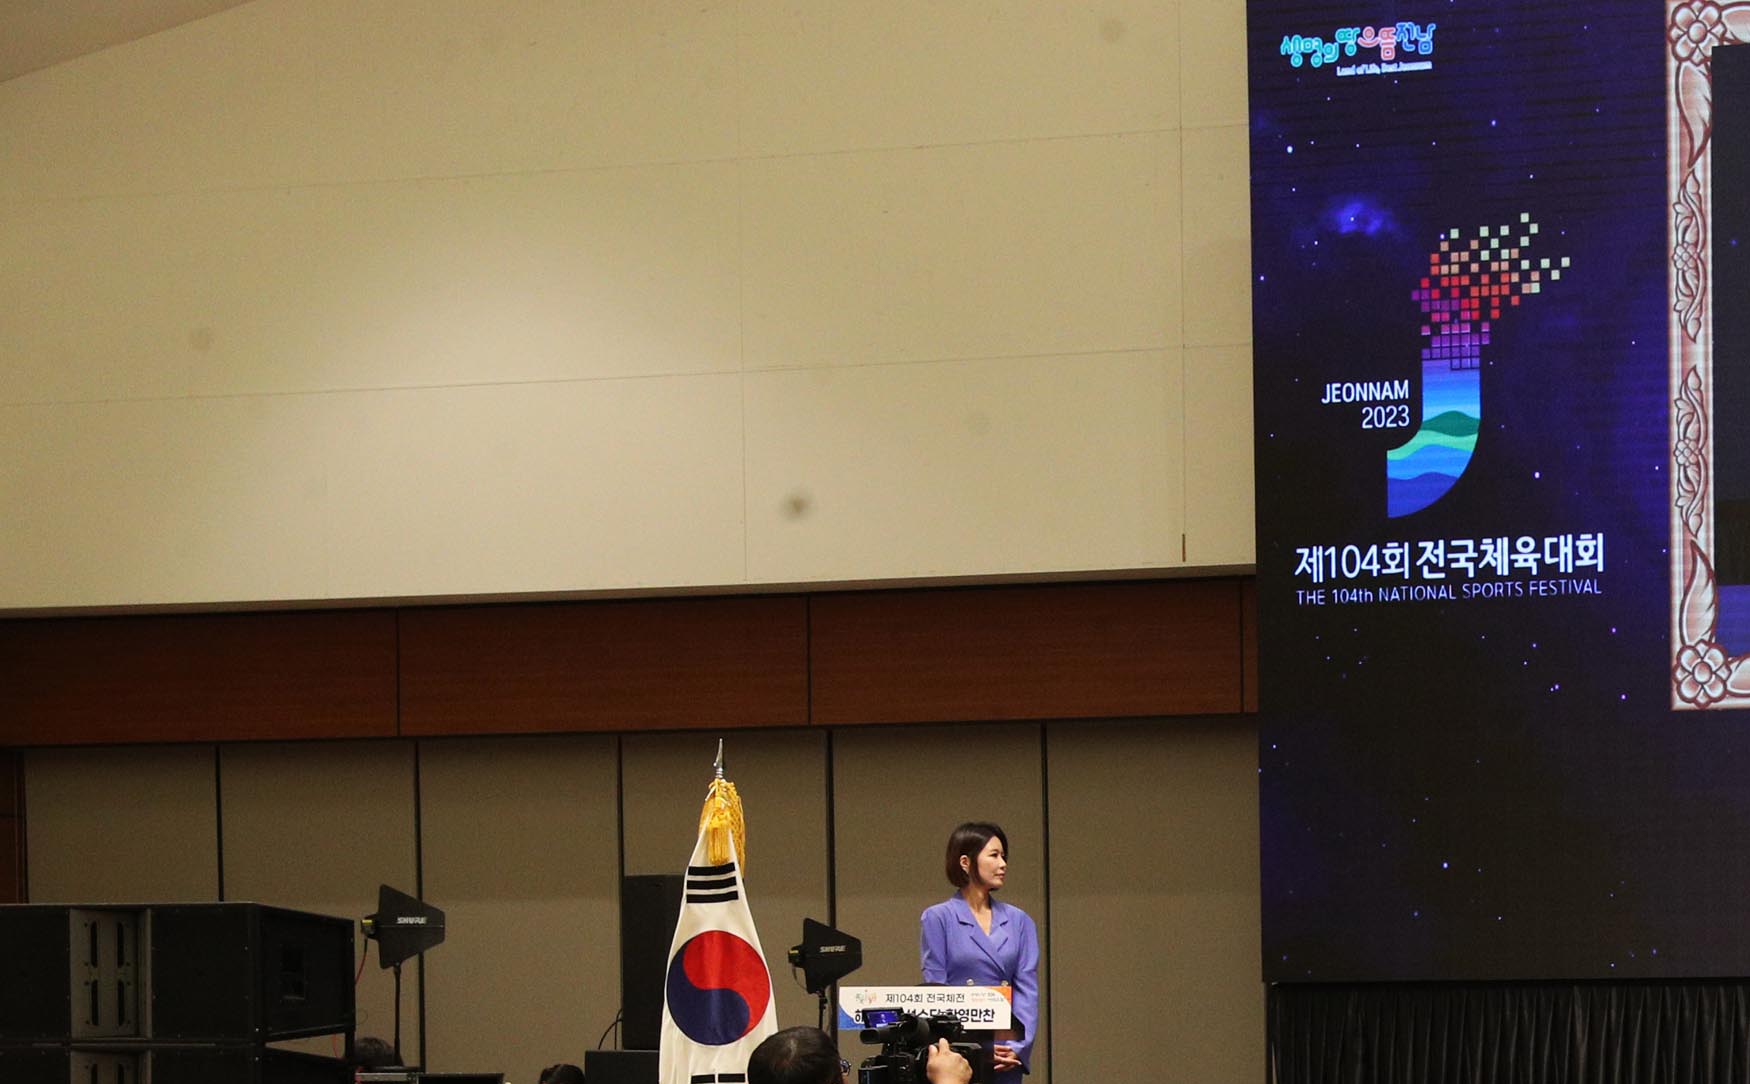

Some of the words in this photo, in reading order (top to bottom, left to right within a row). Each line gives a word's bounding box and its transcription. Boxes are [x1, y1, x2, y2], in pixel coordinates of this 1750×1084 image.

[1321, 380, 1410, 404] JEONNAM
[1362, 405, 1410, 429] 2023
[1294, 542, 1411, 583] 제104회
[1296, 589, 1325, 606] THE
[1332, 588, 1373, 604] 104th
[1378, 585, 1457, 602] NATIONAL
[1462, 581, 1524, 599] SPORTS
[1529, 578, 1602, 597] FESTIVAL
[885, 993, 923, 1004] 제104회
[926, 993, 965, 1003] 전국체전
